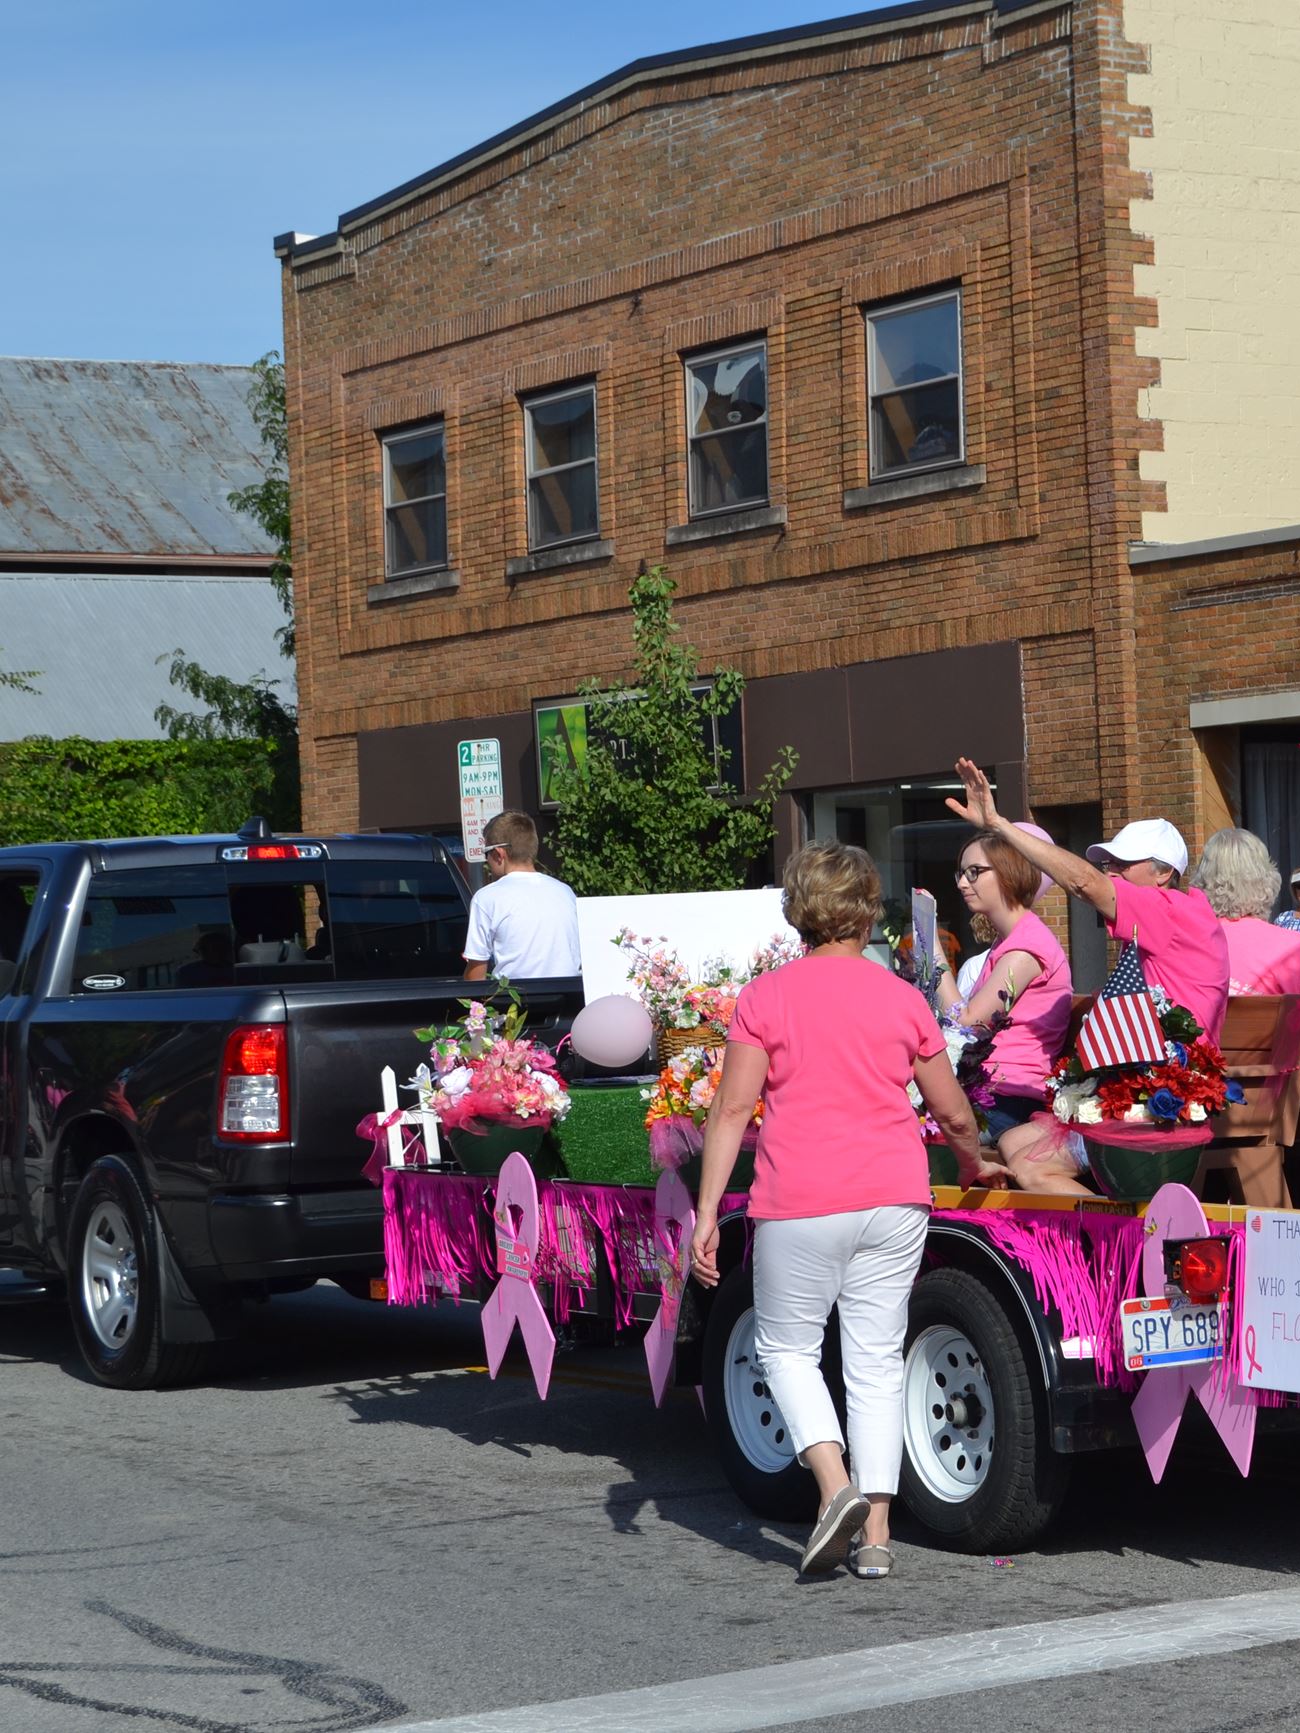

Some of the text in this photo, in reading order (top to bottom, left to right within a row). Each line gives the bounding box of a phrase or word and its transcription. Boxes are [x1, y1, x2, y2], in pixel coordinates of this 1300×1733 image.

[461, 743, 490, 763] 2 HR
[472, 753, 498, 763] PARKING
[463, 771, 498, 783] 9AM-9PM
[465, 785, 498, 797] MON-SAT
[1257, 1275, 1286, 1297] WHO
[1132, 1309, 1222, 1353] SPY 689
[1130, 1358, 1143, 1368] 06
